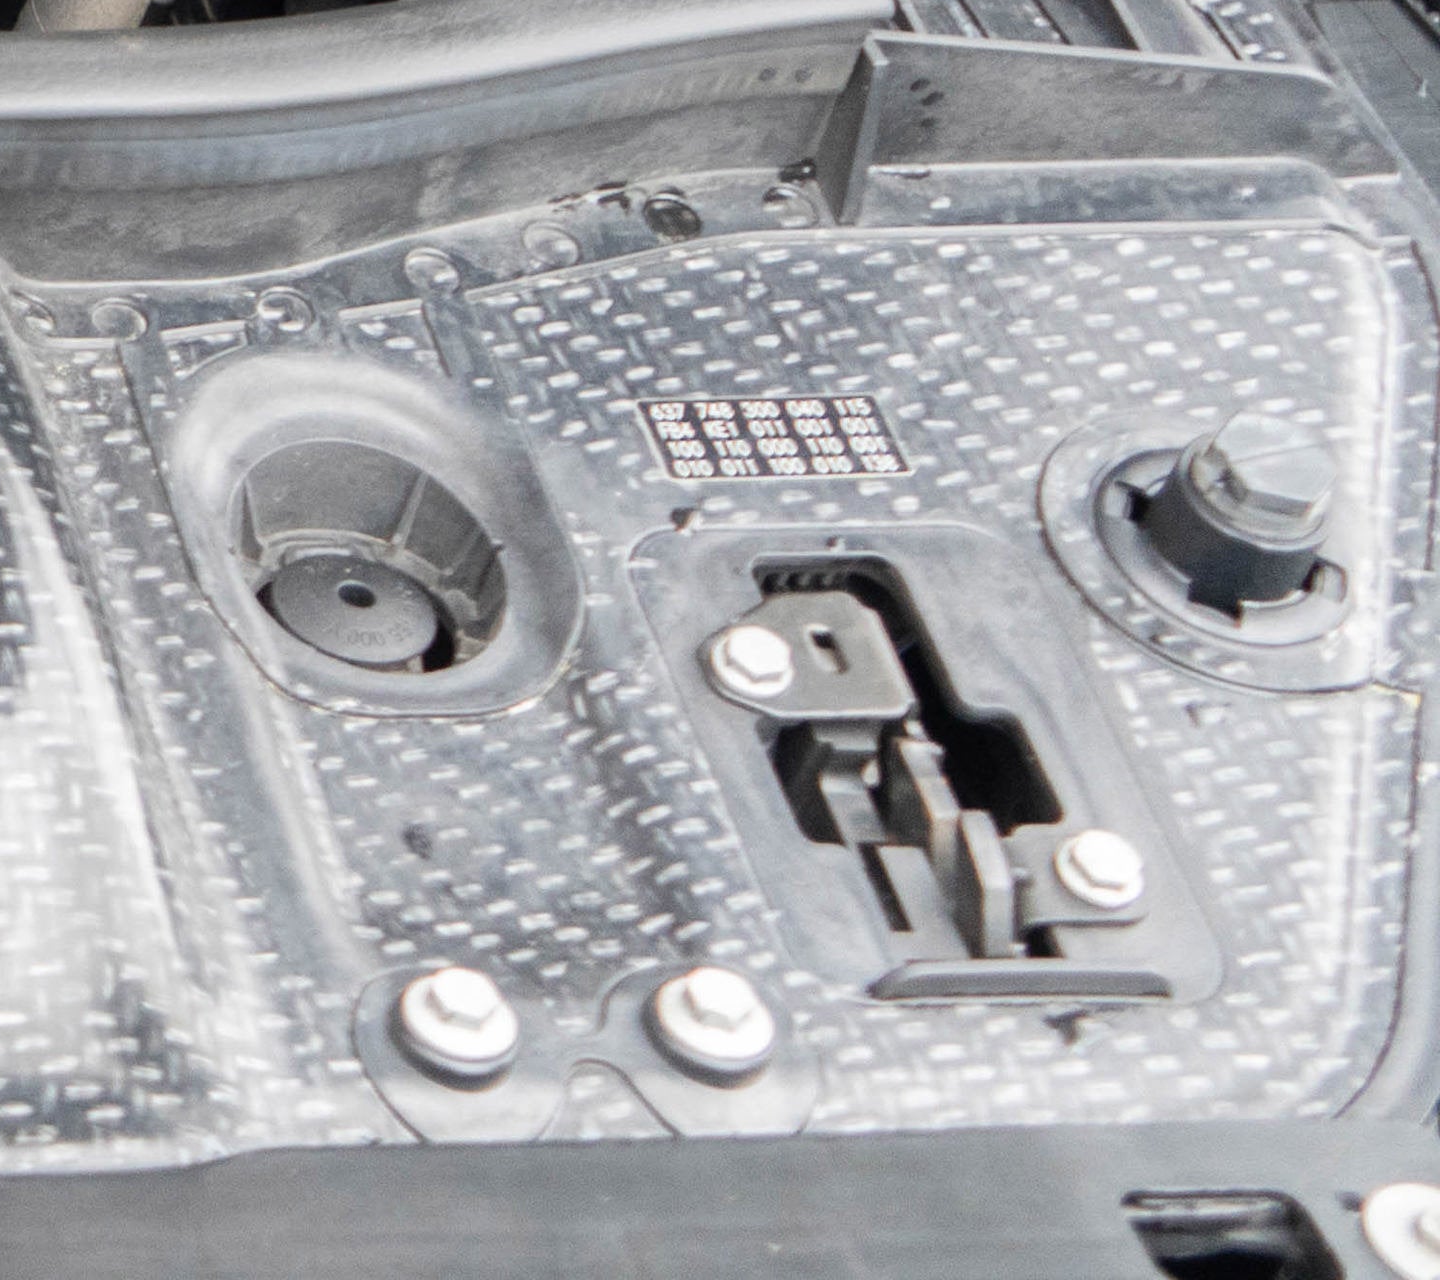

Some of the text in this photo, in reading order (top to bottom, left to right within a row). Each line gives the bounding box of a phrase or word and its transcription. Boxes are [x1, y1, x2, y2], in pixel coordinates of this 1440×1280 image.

[833, 398, 872, 416] 115
[747, 419, 788, 437] 011
[793, 418, 834, 436] 001
[839, 417, 879, 435] 001
[666, 436, 888, 458] 100 110 000 110 001
[673, 459, 714, 477] 010
[719, 458, 760, 476] 011
[766, 457, 807, 475] 100
[811, 456, 853, 474] 010
